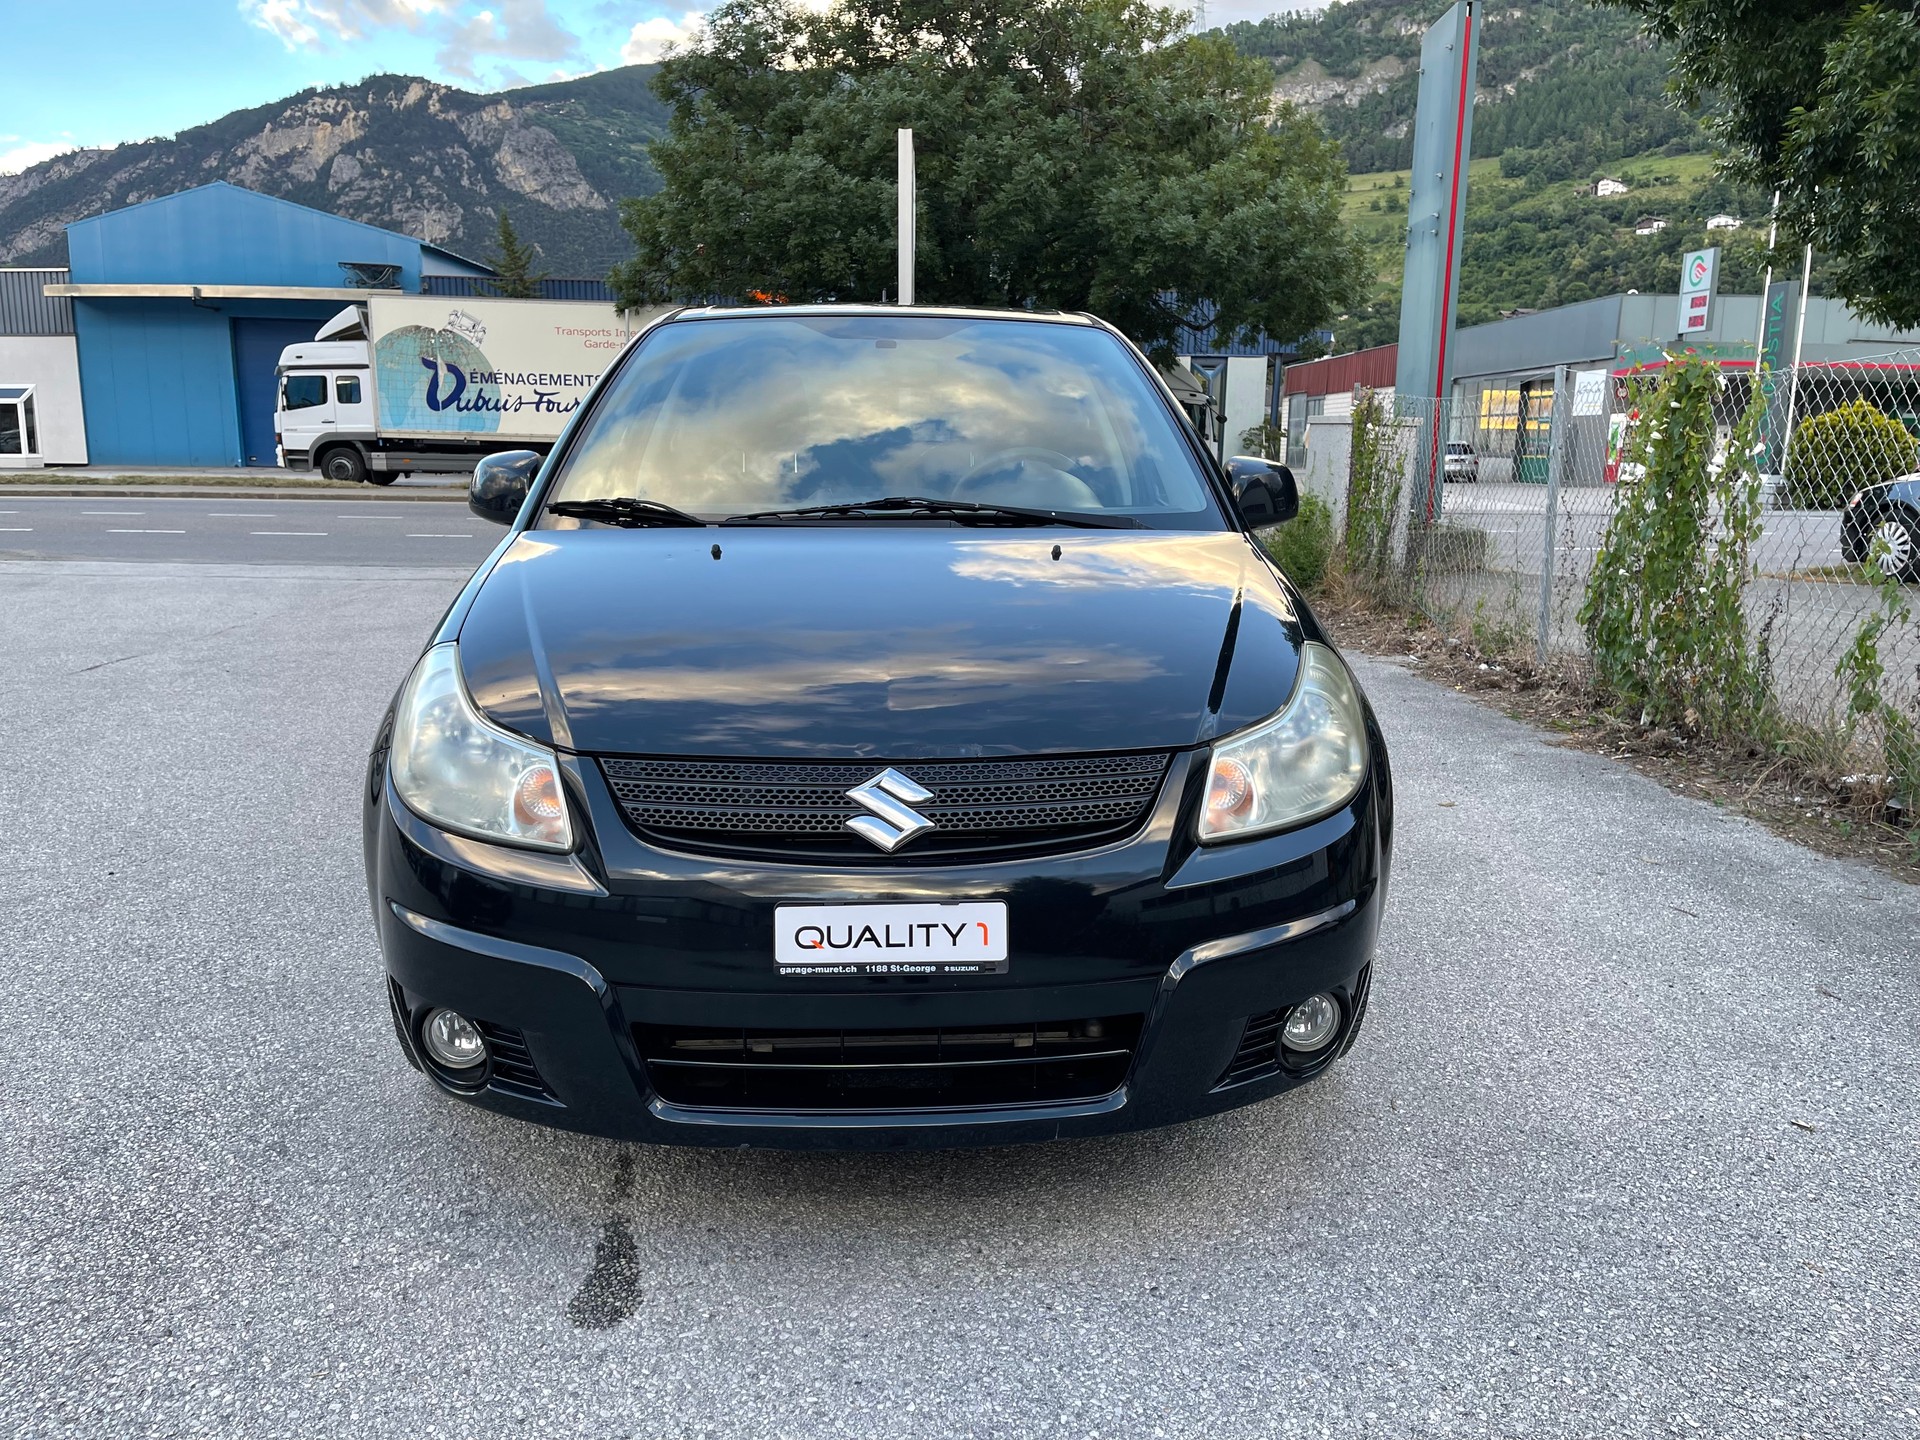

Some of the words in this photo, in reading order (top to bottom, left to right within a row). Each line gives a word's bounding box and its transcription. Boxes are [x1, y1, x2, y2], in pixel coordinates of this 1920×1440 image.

[554, 326, 612, 338] Transports
[794, 922, 967, 950] QUALITY
[779, 965, 857, 974] garage-muret.ch
[865, 964, 888, 973] 1188
[890, 964, 936, 973] St-George
